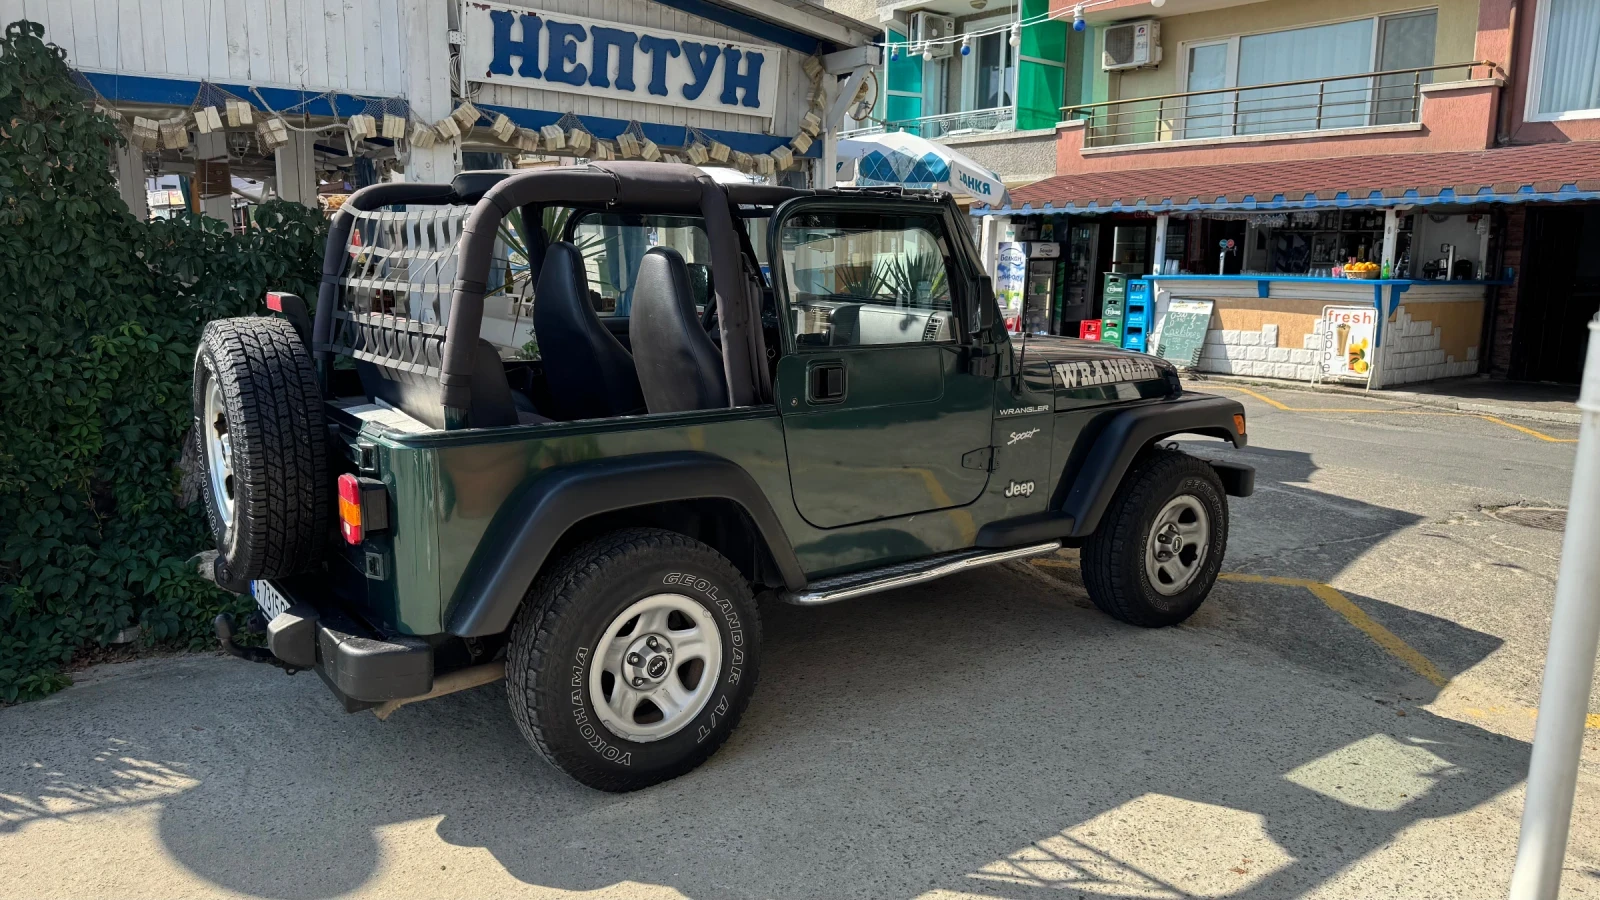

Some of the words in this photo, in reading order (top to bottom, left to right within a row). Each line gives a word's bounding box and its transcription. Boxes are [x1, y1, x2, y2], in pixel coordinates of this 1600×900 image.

[489, 10, 764, 109] НЕПТУН
[1328, 310, 1371, 324] fresh
[1055, 357, 1159, 389] WRANGLER
[999, 404, 1049, 416] WRANGLER
[1005, 480, 1035, 498] Jeep
[662, 572, 744, 686] GEOLANDAR
[651, 661, 664, 673] Jeep
[571, 646, 632, 767] YOKOHAMA
[697, 695, 730, 744] A/T
